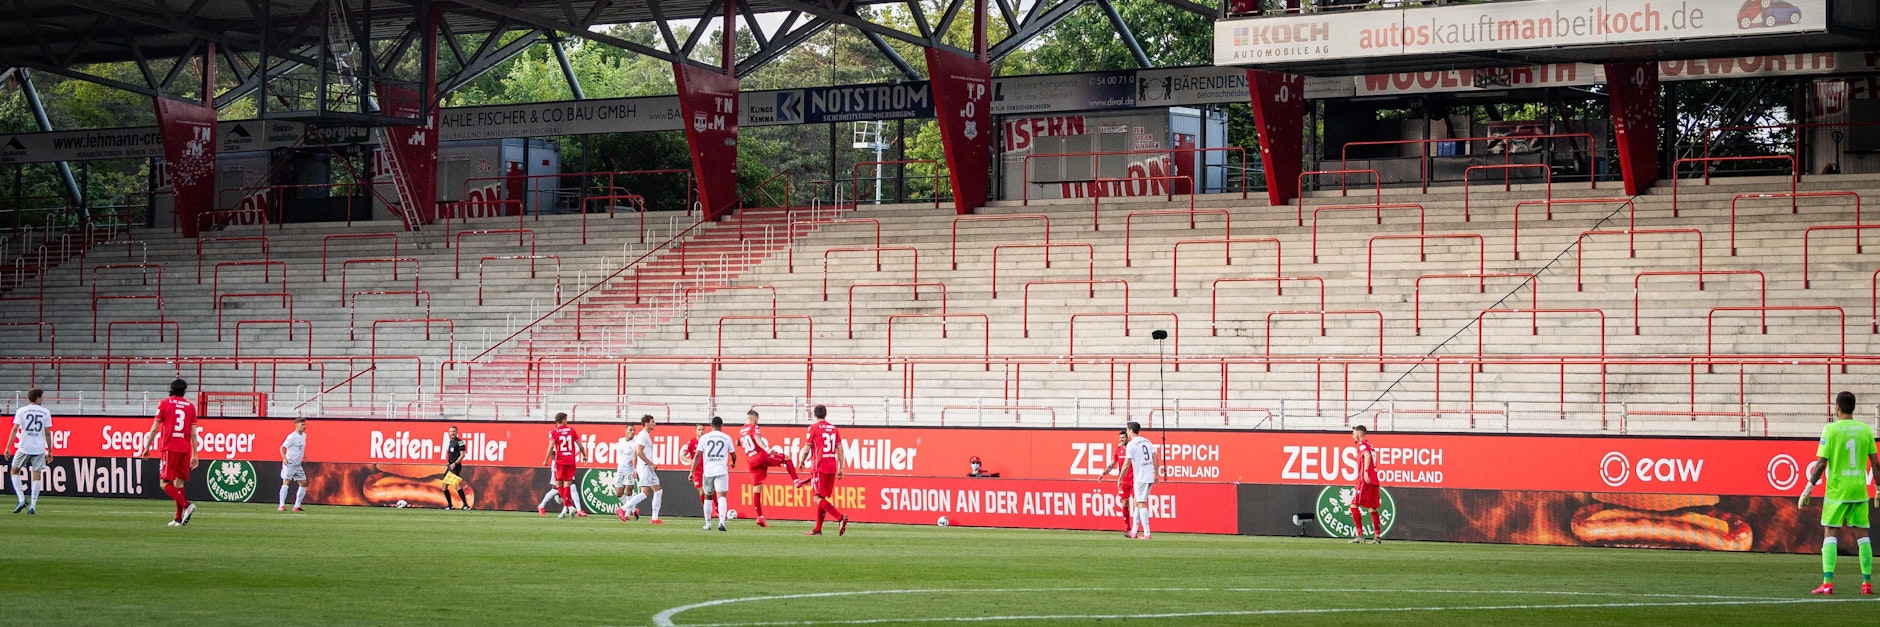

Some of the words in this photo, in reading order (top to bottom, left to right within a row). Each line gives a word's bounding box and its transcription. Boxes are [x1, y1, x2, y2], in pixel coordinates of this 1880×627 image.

[1252, 22, 1330, 46] KOCH
[1359, 2, 1704, 49] autoskauftmanbeikoch.de
[1234, 46, 1309, 59] AUTOMOBILE
[1315, 45, 1329, 54] AG
[1096, 76, 1106, 85] 54
[1107, 76, 1117, 84] 00
[1129, 75, 1135, 83] 0
[812, 84, 927, 113] NOTSTROM
[442, 112, 475, 129] AHLE,
[478, 110, 527, 126] FISCHER
[531, 107, 538, 118] &
[542, 107, 565, 123] CO.
[568, 105, 594, 120] BAU
[599, 104, 637, 120] GMBH
[26, 413, 43, 432] 25
[174, 409, 185, 431] 3
[102, 425, 161, 456] Seeger
[195, 426, 256, 459] Seeger
[559, 434, 572, 451] 21
[707, 440, 725, 457] 22
[822, 433, 836, 453] 31
[1070, 443, 1120, 476] ZEU
[1142, 445, 1150, 461] 9
[1282, 446, 1358, 481] ZEUS
[1846, 439, 1856, 467] 1
[73, 457, 143, 495] Wahl!
[1158, 465, 1220, 478] ODENLAND
[1377, 470, 1443, 483] ODENLAND
[1635, 458, 1704, 482] eaw
[208, 477, 254, 502] EBERSWALDER
[741, 484, 813, 507] HNDERT
[881, 487, 951, 512] STADION
[956, 490, 984, 514] AN
[985, 491, 1018, 514] DER
[1022, 491, 1077, 516] ALTEN
[1082, 489, 1177, 519] FÖRSREI
